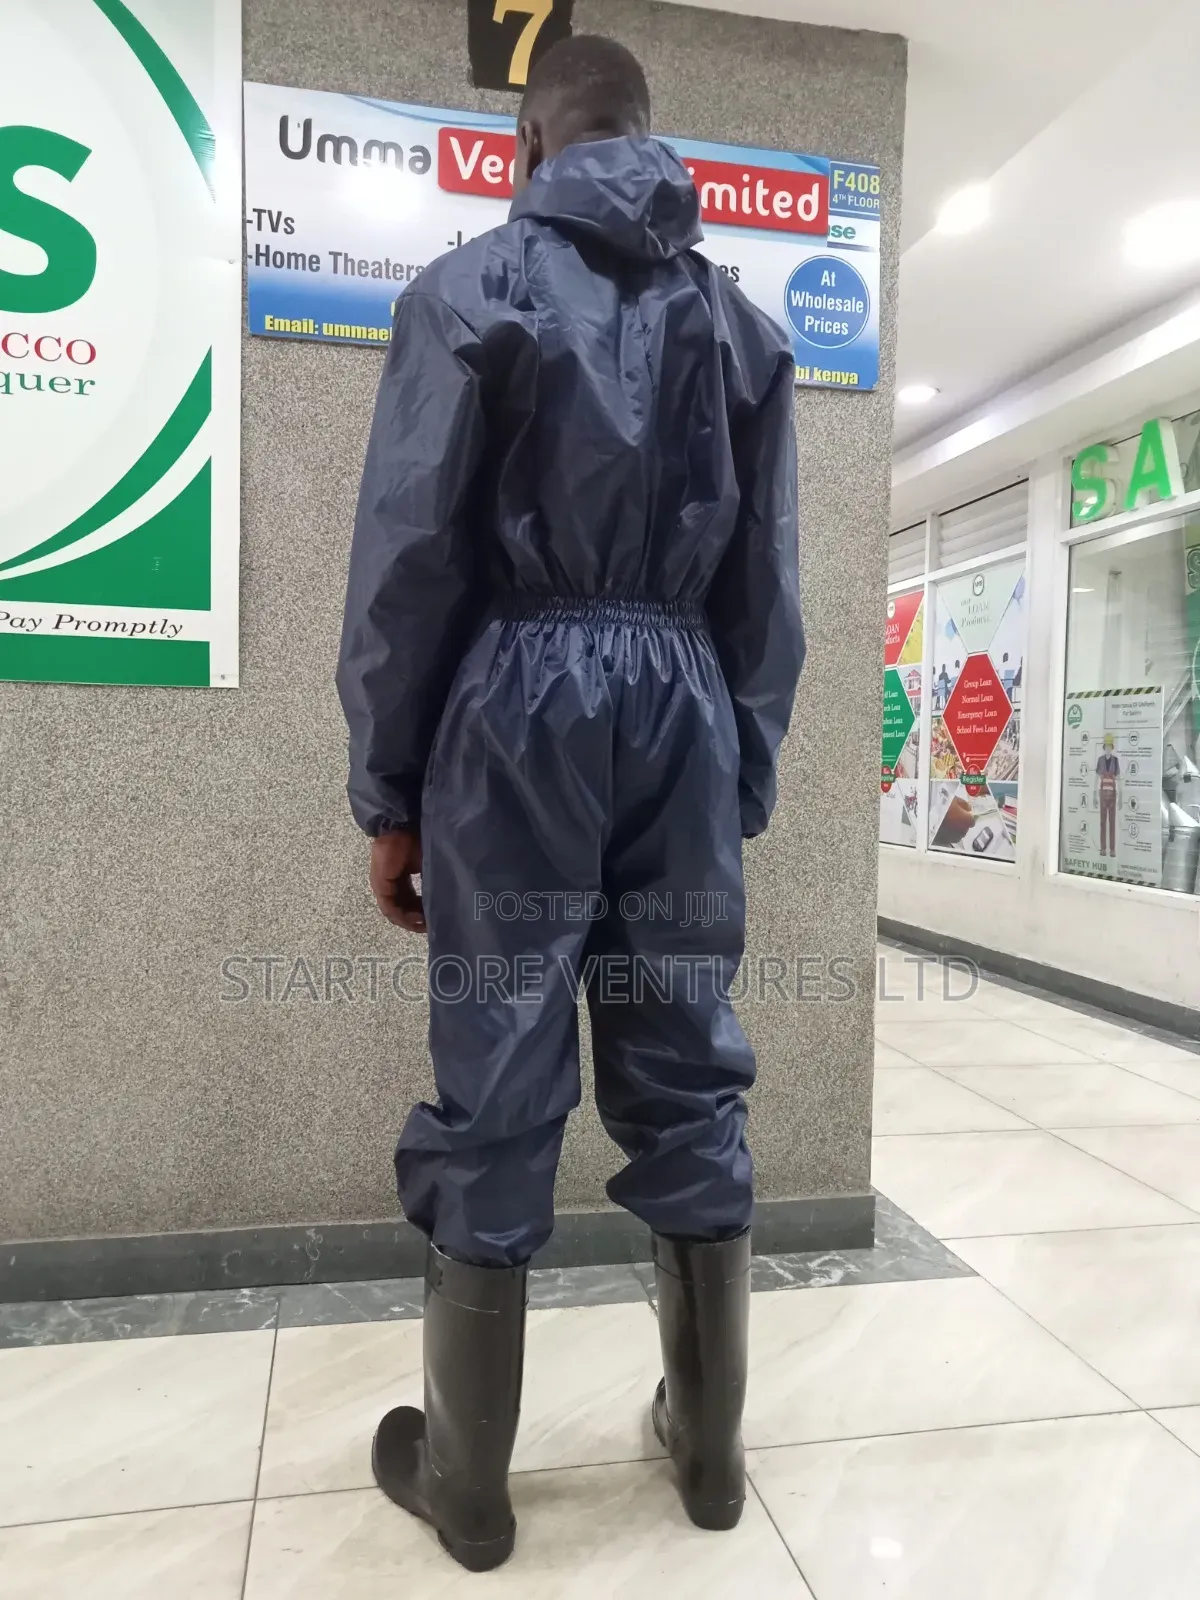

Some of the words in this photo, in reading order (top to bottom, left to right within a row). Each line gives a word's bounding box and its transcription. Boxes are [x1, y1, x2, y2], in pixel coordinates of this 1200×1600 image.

[492, 0, 554, 86] 7
[278, 115, 432, 175] Umma
[448, 136, 516, 186] Ve
[687, 166, 821, 223] mited
[833, 169, 880, 195] F408
[848, 194, 880, 209] FLOOR
[0, 125, 97, 314] S
[828, 224, 857, 240] se
[820, 270, 837, 287] At
[790, 289, 865, 314] Wholesale
[264, 314, 319, 335] Email:
[322, 322, 393, 342] ummae
[804, 315, 849, 335] Prices
[1, 332, 97, 365] CCO
[0, 371, 96, 396] quer
[813, 366, 859, 386] kenya
[1071, 417, 1178, 522] SA
[0, 610, 43, 633] Pay
[52, 613, 184, 639] Promptly
[979, 677, 993, 687] Loan
[980, 693, 994, 702] Loan
[984, 708, 998, 718] Loan
[984, 724, 998, 733] Loan
[1064, 857, 1091, 869] SAFETY
[1092, 861, 1108, 871] HUB
